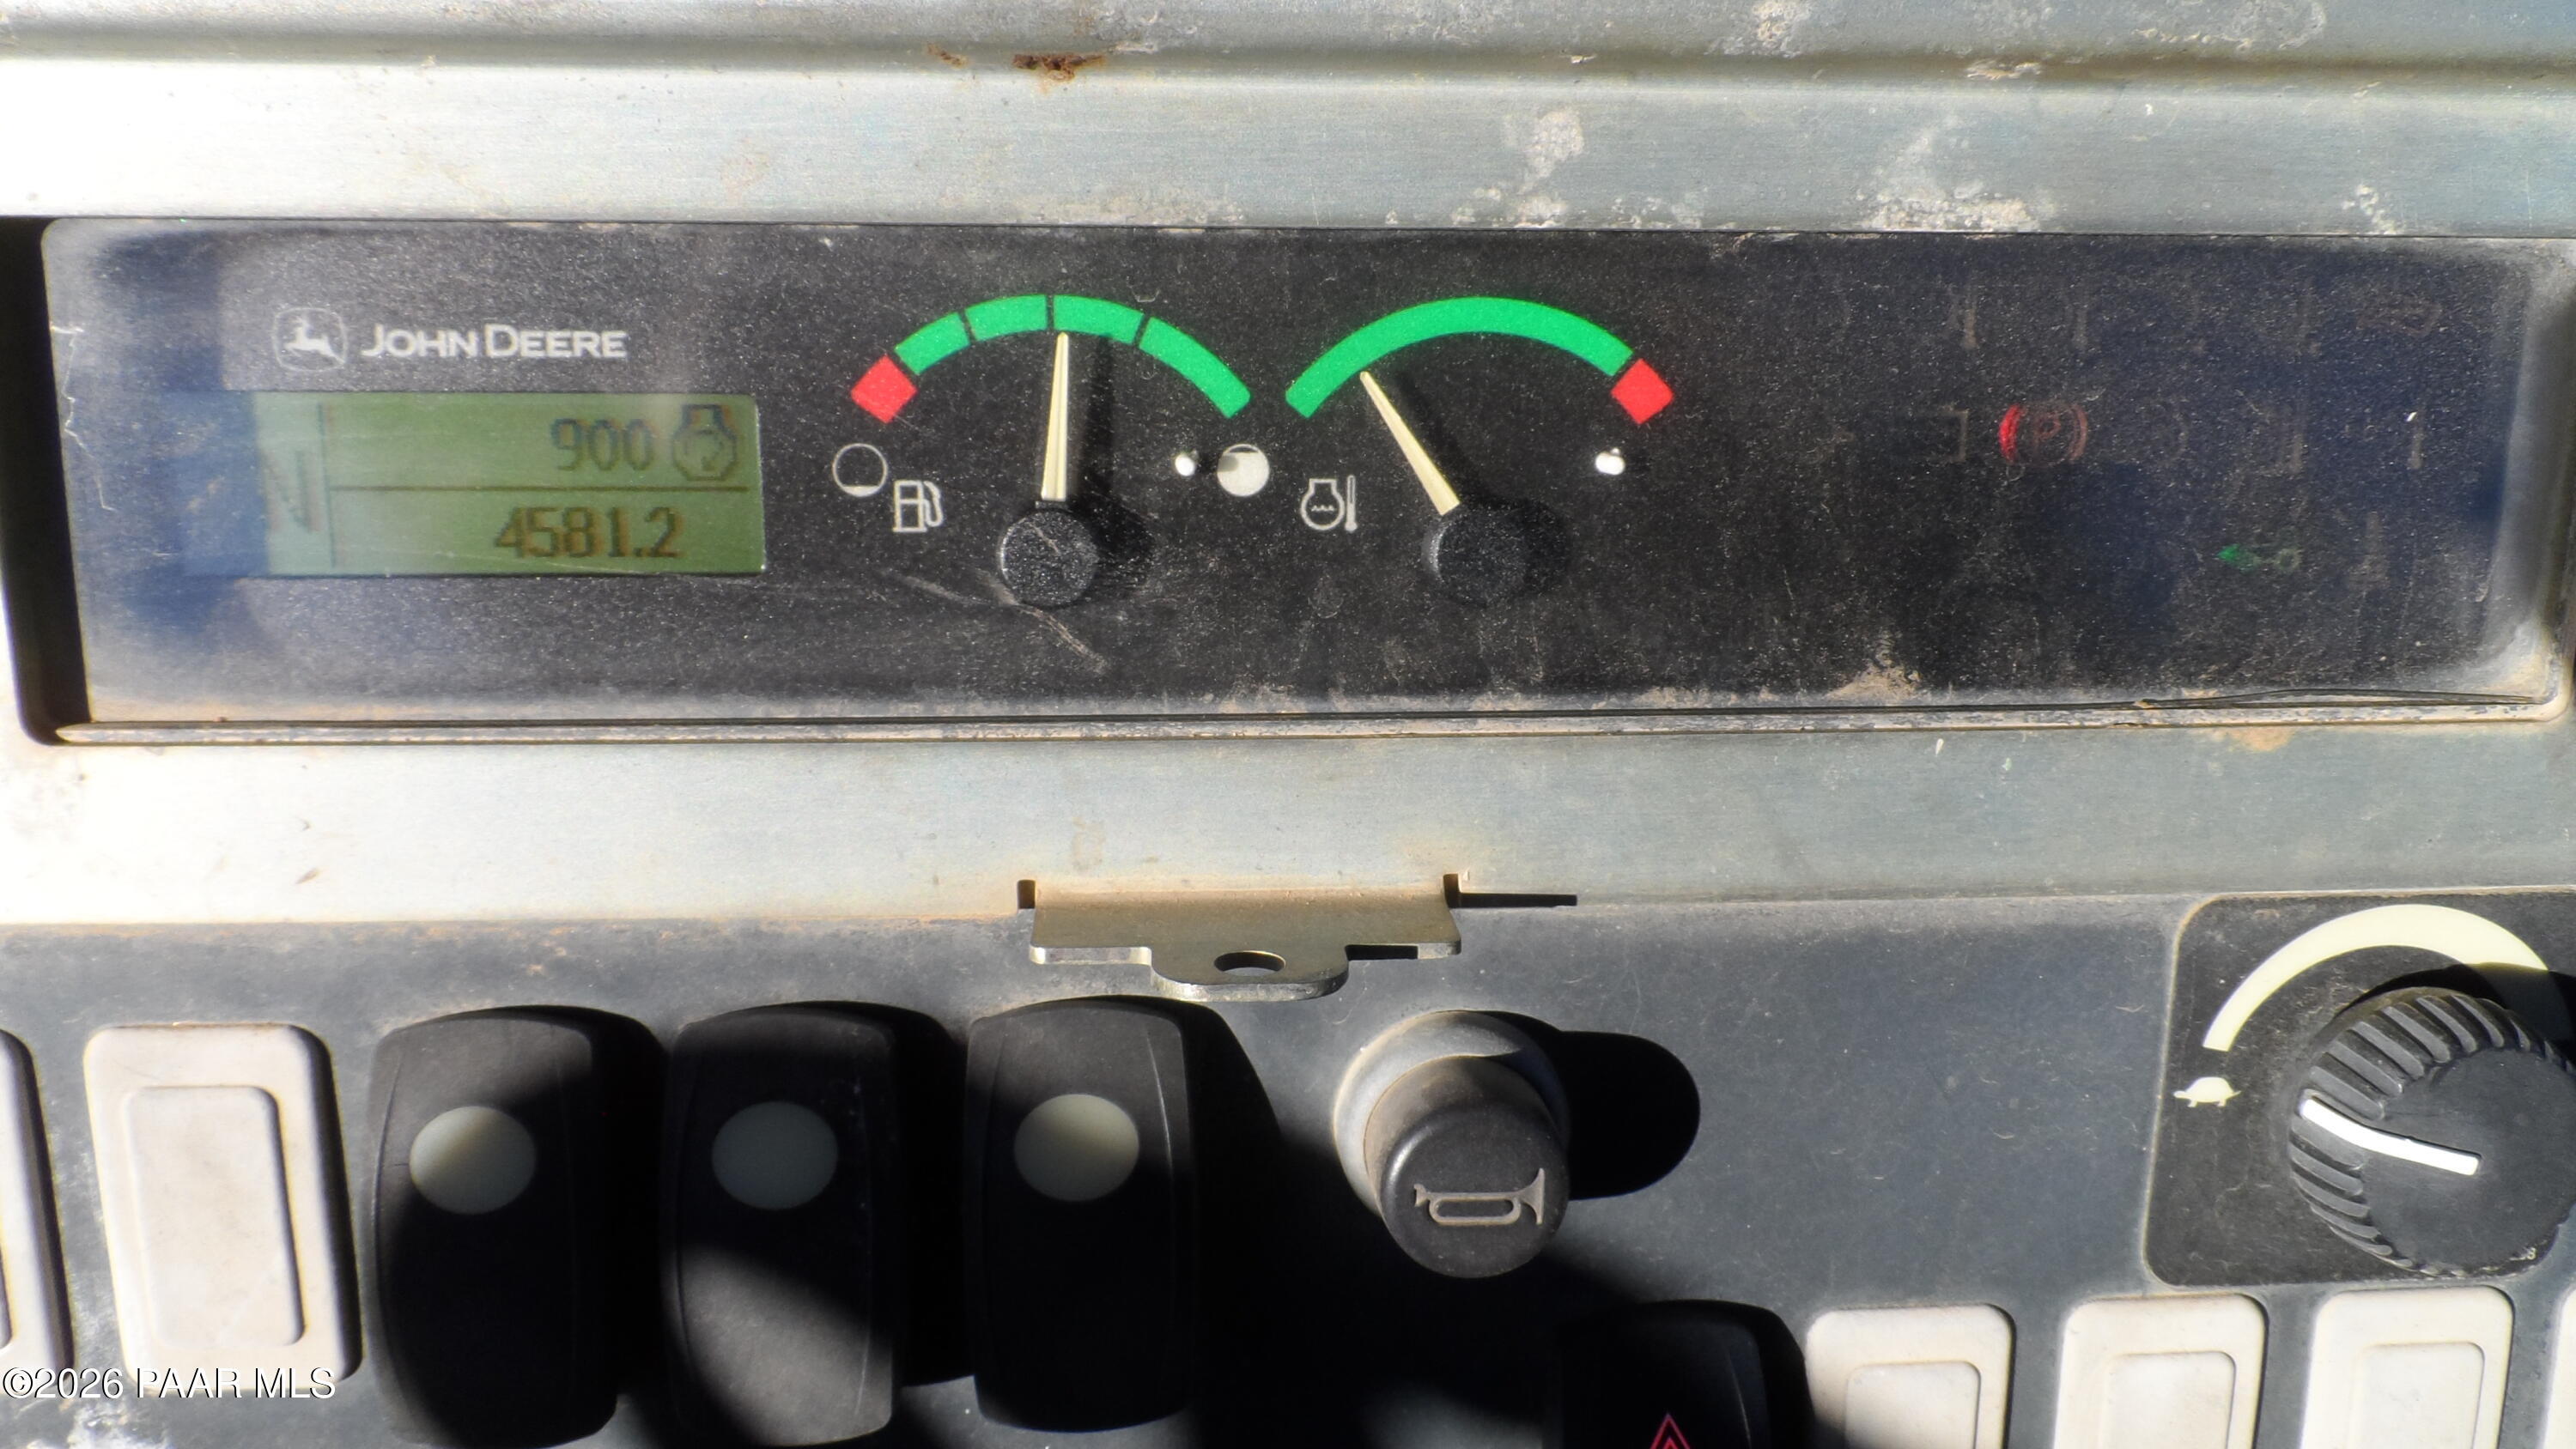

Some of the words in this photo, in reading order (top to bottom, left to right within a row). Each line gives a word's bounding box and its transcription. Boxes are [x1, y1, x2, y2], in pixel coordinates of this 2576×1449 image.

[361, 324, 477, 359] JOHN
[485, 324, 629, 359] DEERE
[551, 417, 656, 471] 900
[495, 505, 684, 560] 4581.2
